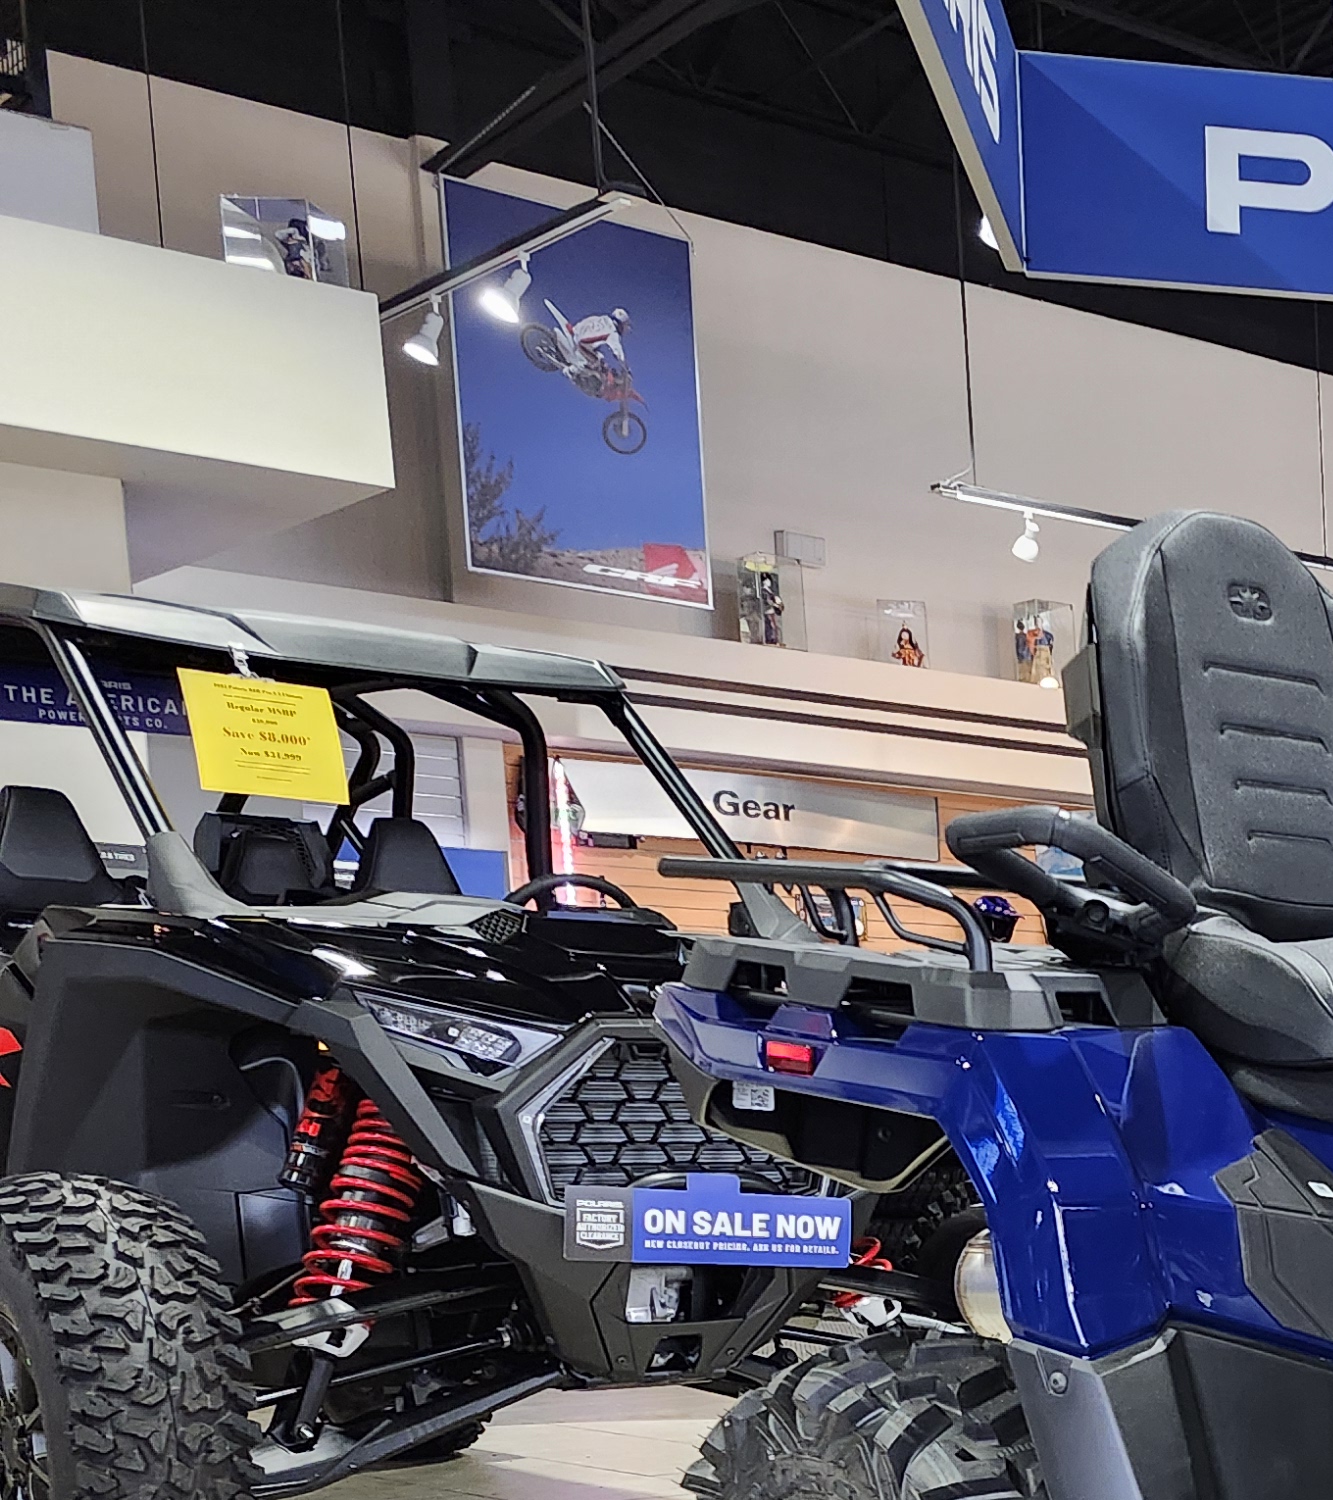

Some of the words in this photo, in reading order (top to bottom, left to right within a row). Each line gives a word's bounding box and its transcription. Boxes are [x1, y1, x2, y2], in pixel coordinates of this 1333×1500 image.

[3, 684, 54, 704] THE
[226, 701, 264, 714] Regular
[267, 706, 297, 718] MSRP
[145, 716, 168, 729] CO.
[222, 727, 255, 740] Save
[240, 747, 261, 757] Now
[712, 788, 796, 822] Gear
[582, 1213, 619, 1223] FACTORY
[643, 1208, 687, 1235] ON
[692, 1210, 770, 1239] SALE
[776, 1213, 842, 1241] NOW
[644, 1240, 664, 1249] NEW
[666, 1240, 711, 1251] CLOSEOUT
[771, 1243, 783, 1253] US
[784, 1244, 801, 1254] FOR
